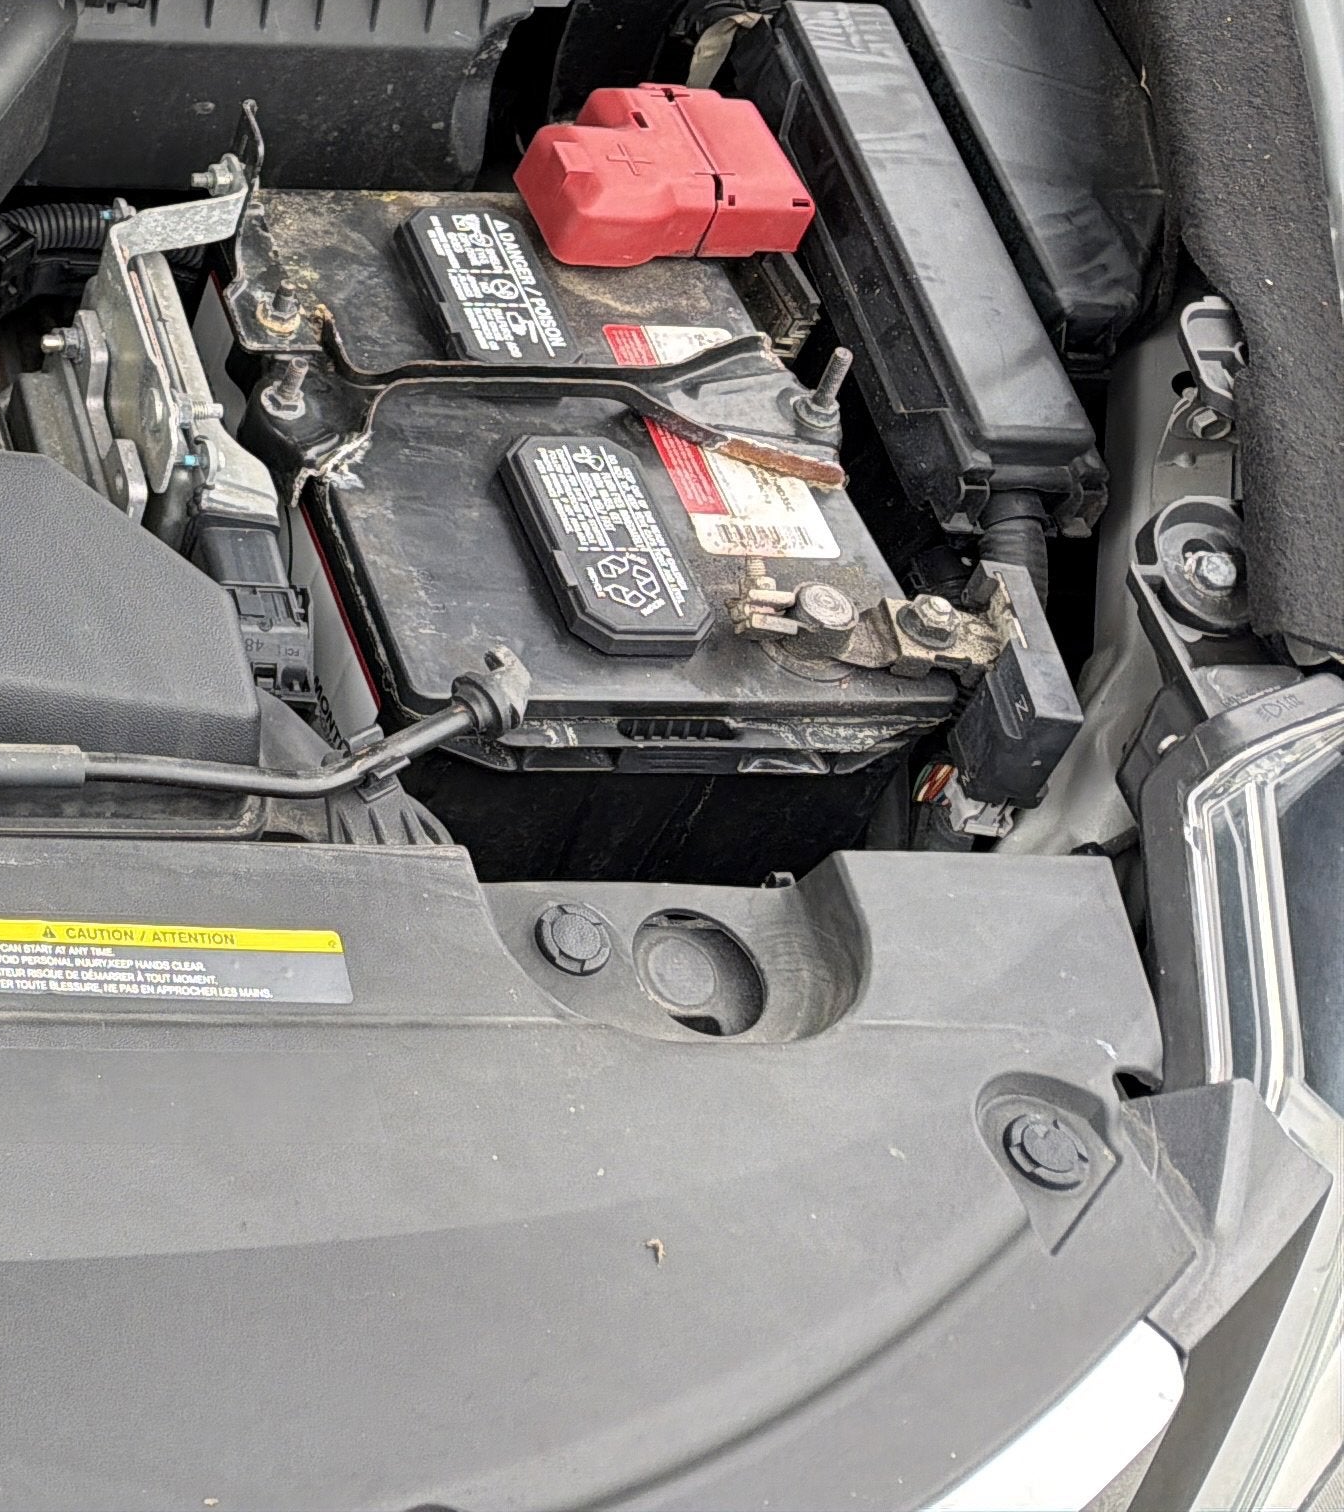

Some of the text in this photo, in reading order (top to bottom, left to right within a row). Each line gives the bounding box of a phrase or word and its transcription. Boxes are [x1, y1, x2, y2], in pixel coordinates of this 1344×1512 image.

[498, 232, 537, 284] DANGER
[528, 297, 567, 346] POISON
[66, 927, 134, 941] CAUTION
[152, 931, 235, 946] ATTENTION
[0, 943, 22, 954] CAN
[24, 944, 52, 954] START
[55, 945, 66, 955] AT
[68, 946, 88, 956] ANY
[22, 956, 73, 968] PERSONAL
[135, 960, 170, 970] HANDS
[172, 961, 206, 972] CLEAR.
[27, 968, 63, 979] RISQUE
[66, 970, 79, 980] DE
[146, 973, 170, 984] TOUT
[16, 980, 47, 990] TOUTE
[104, 983, 118, 993] NE
[120, 984, 138, 994] PAS
[141, 984, 155, 994] EN
[157, 985, 218, 996] APPROCHER
[218, 986, 238, 997] LES
